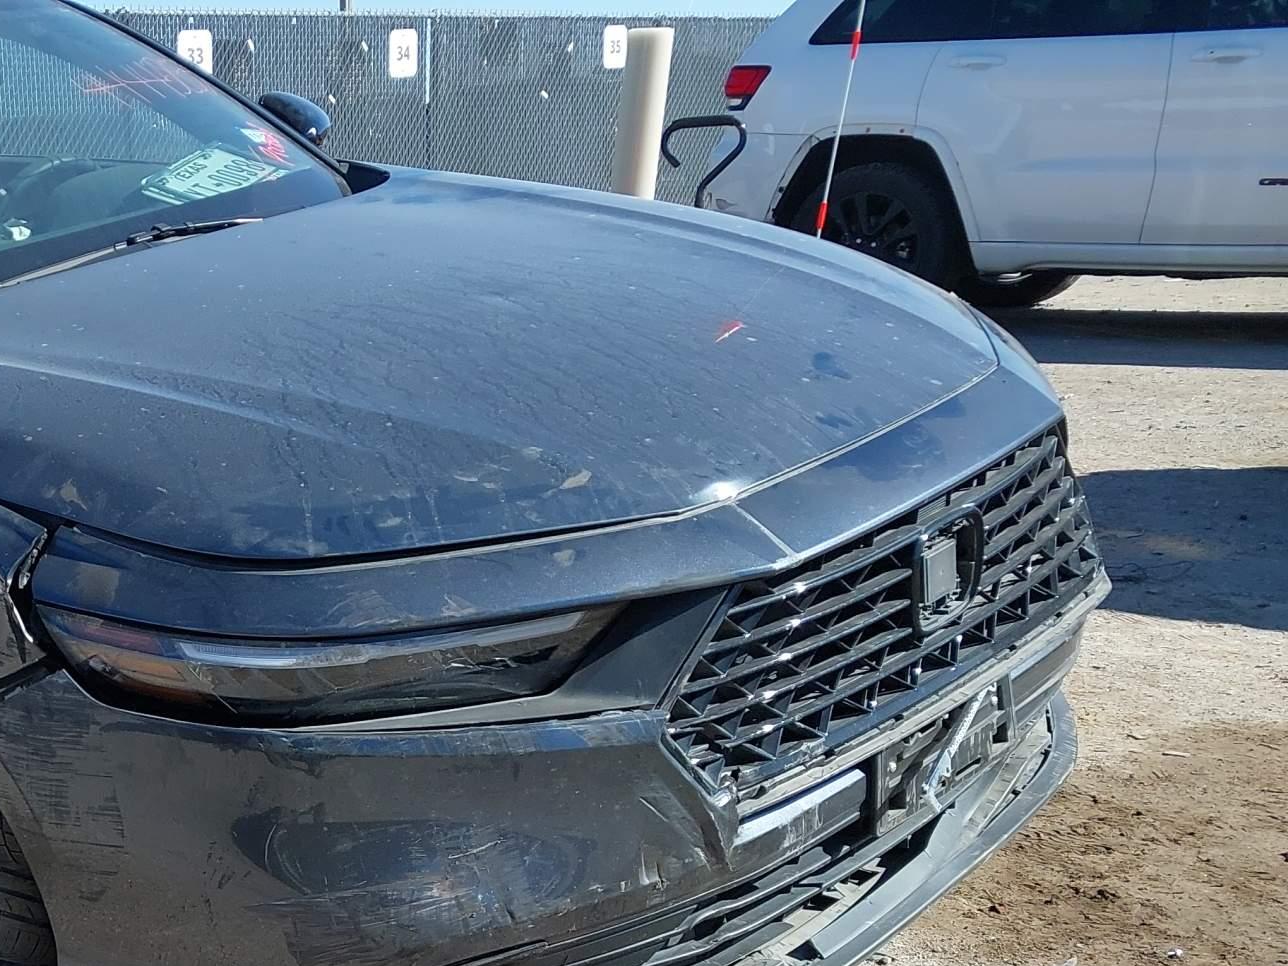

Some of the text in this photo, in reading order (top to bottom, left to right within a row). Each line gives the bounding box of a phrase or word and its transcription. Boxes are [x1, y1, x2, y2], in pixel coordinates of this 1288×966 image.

[396, 45, 410, 61] 34
[610, 39, 621, 54] 35
[187, 47, 204, 65] 33
[174, 160, 208, 182] TEXAS
